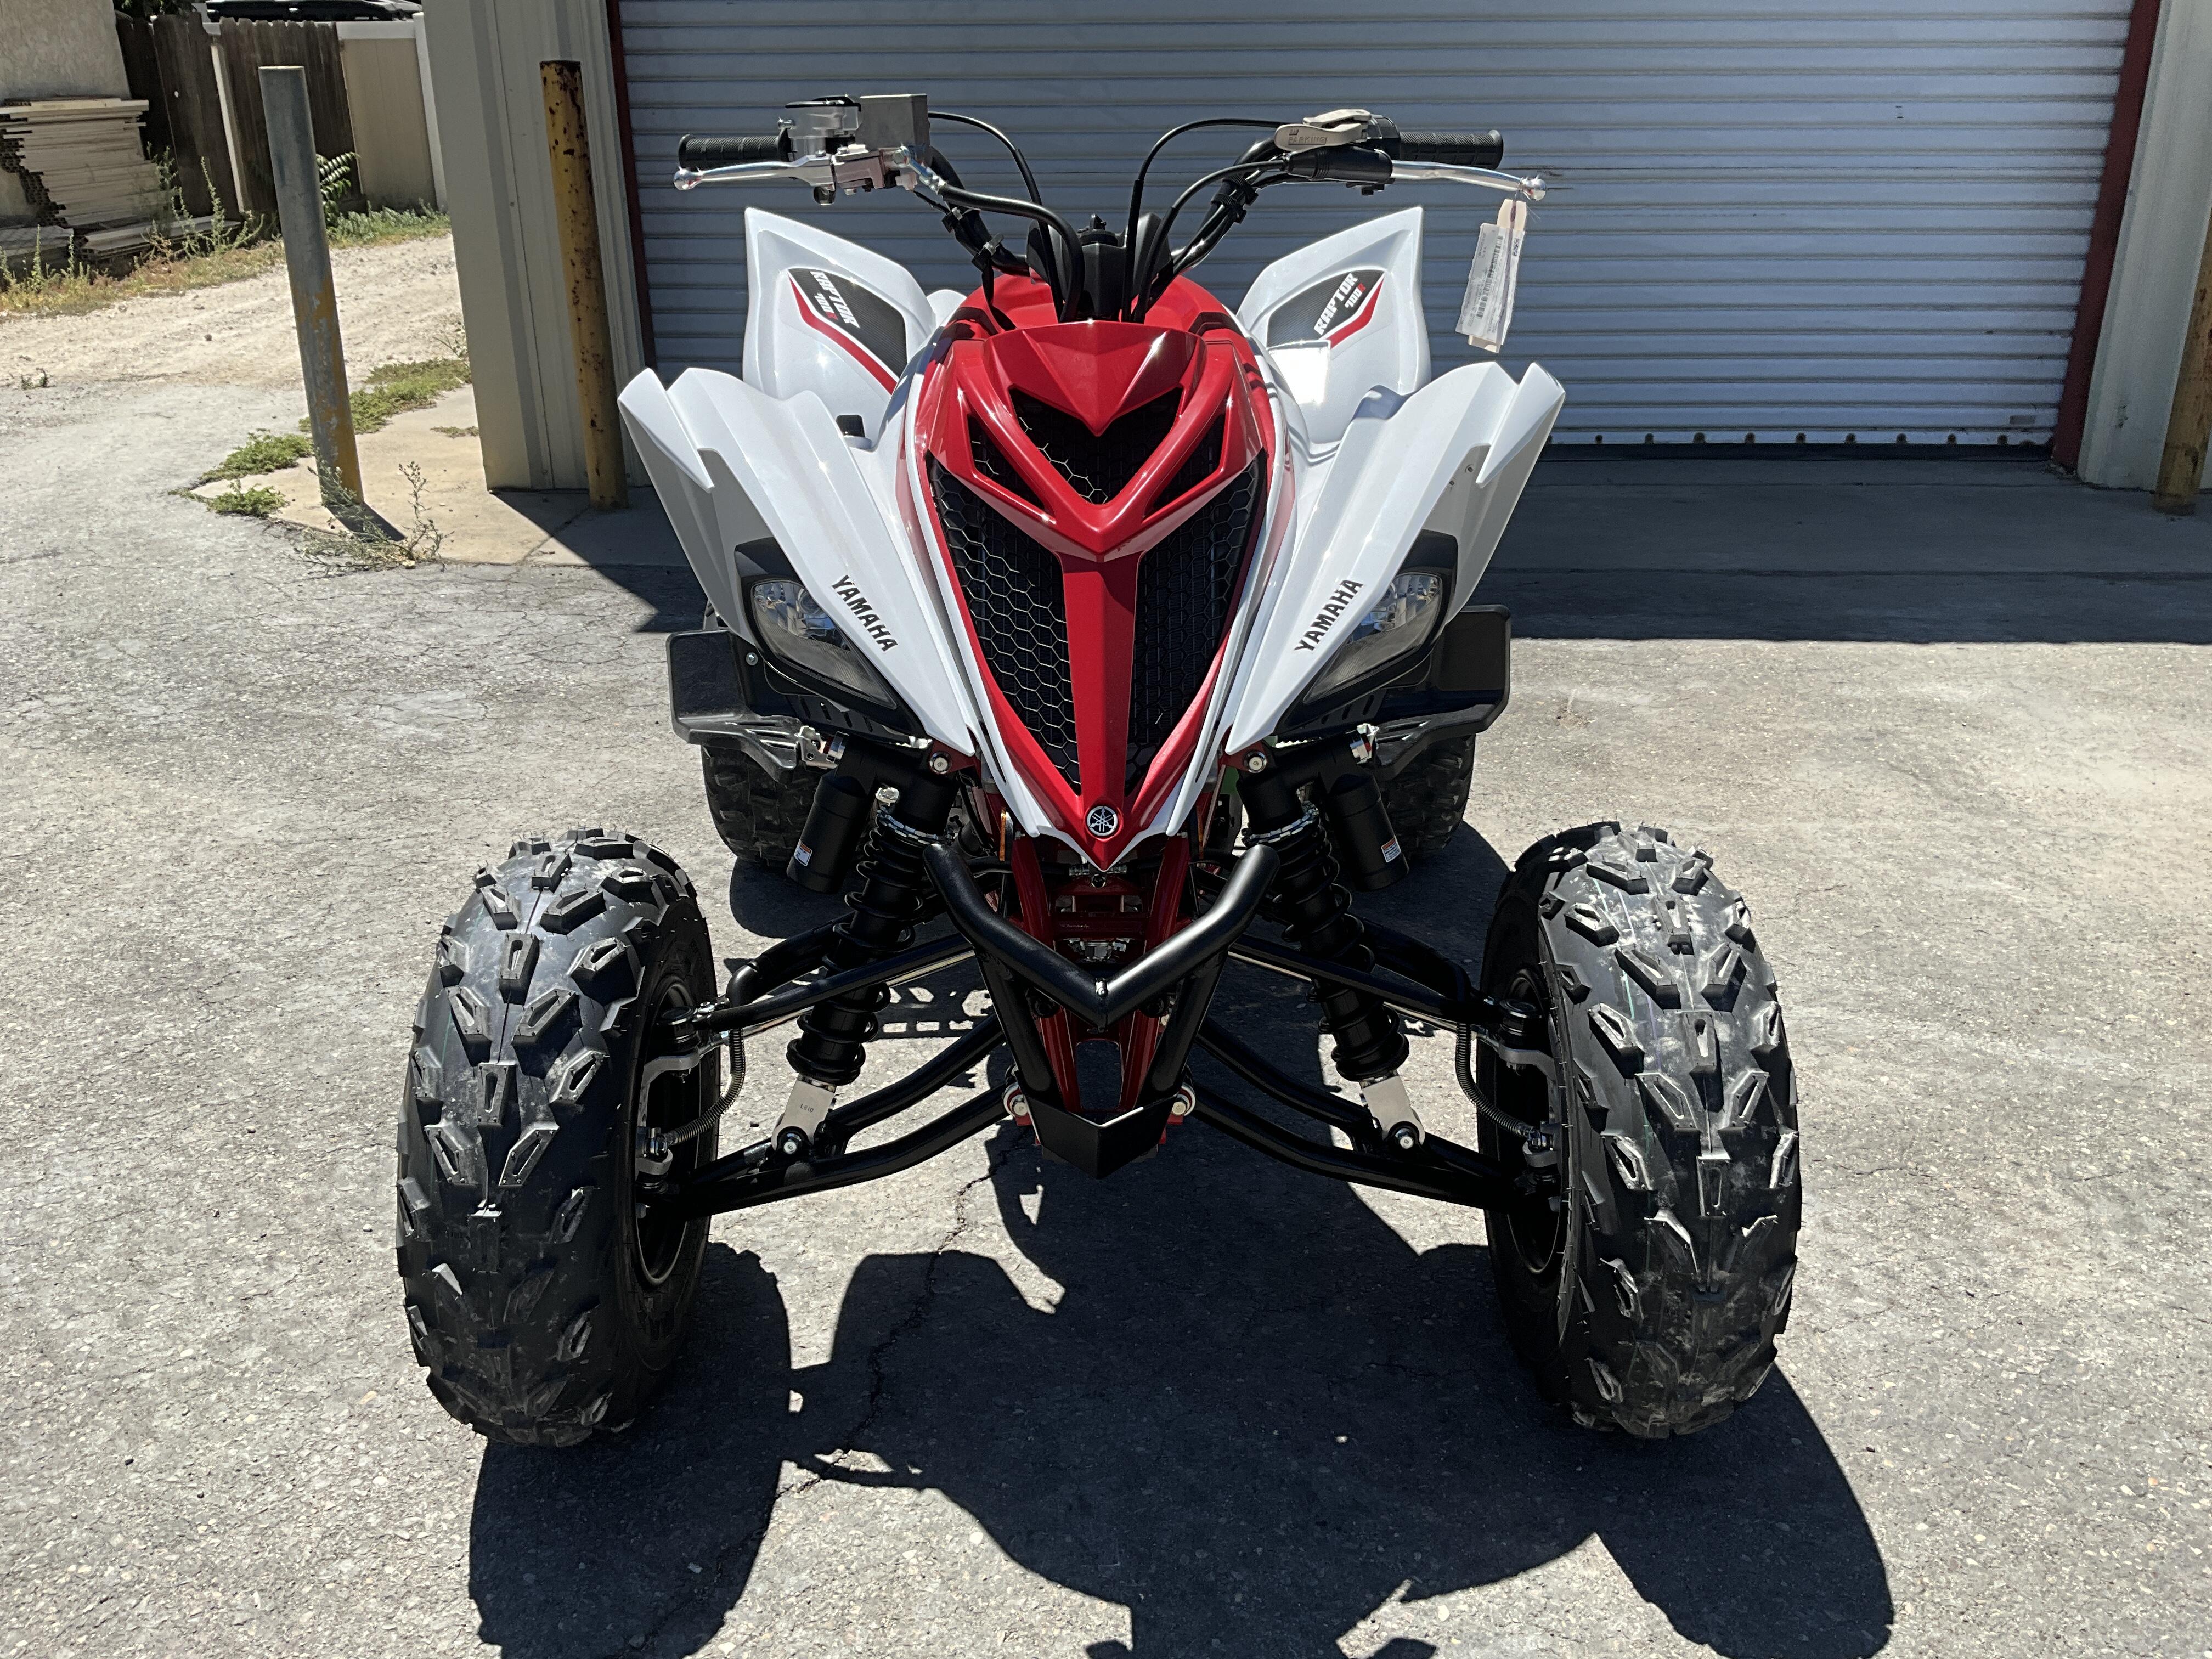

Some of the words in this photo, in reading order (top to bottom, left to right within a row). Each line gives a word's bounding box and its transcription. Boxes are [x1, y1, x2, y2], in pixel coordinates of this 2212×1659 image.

[810, 271, 860, 328] RAPTOR
[1314, 273, 1358, 335] RAPTOR
[832, 575, 898, 651] YAMAHA
[1294, 579, 1363, 651] YAMAHA
